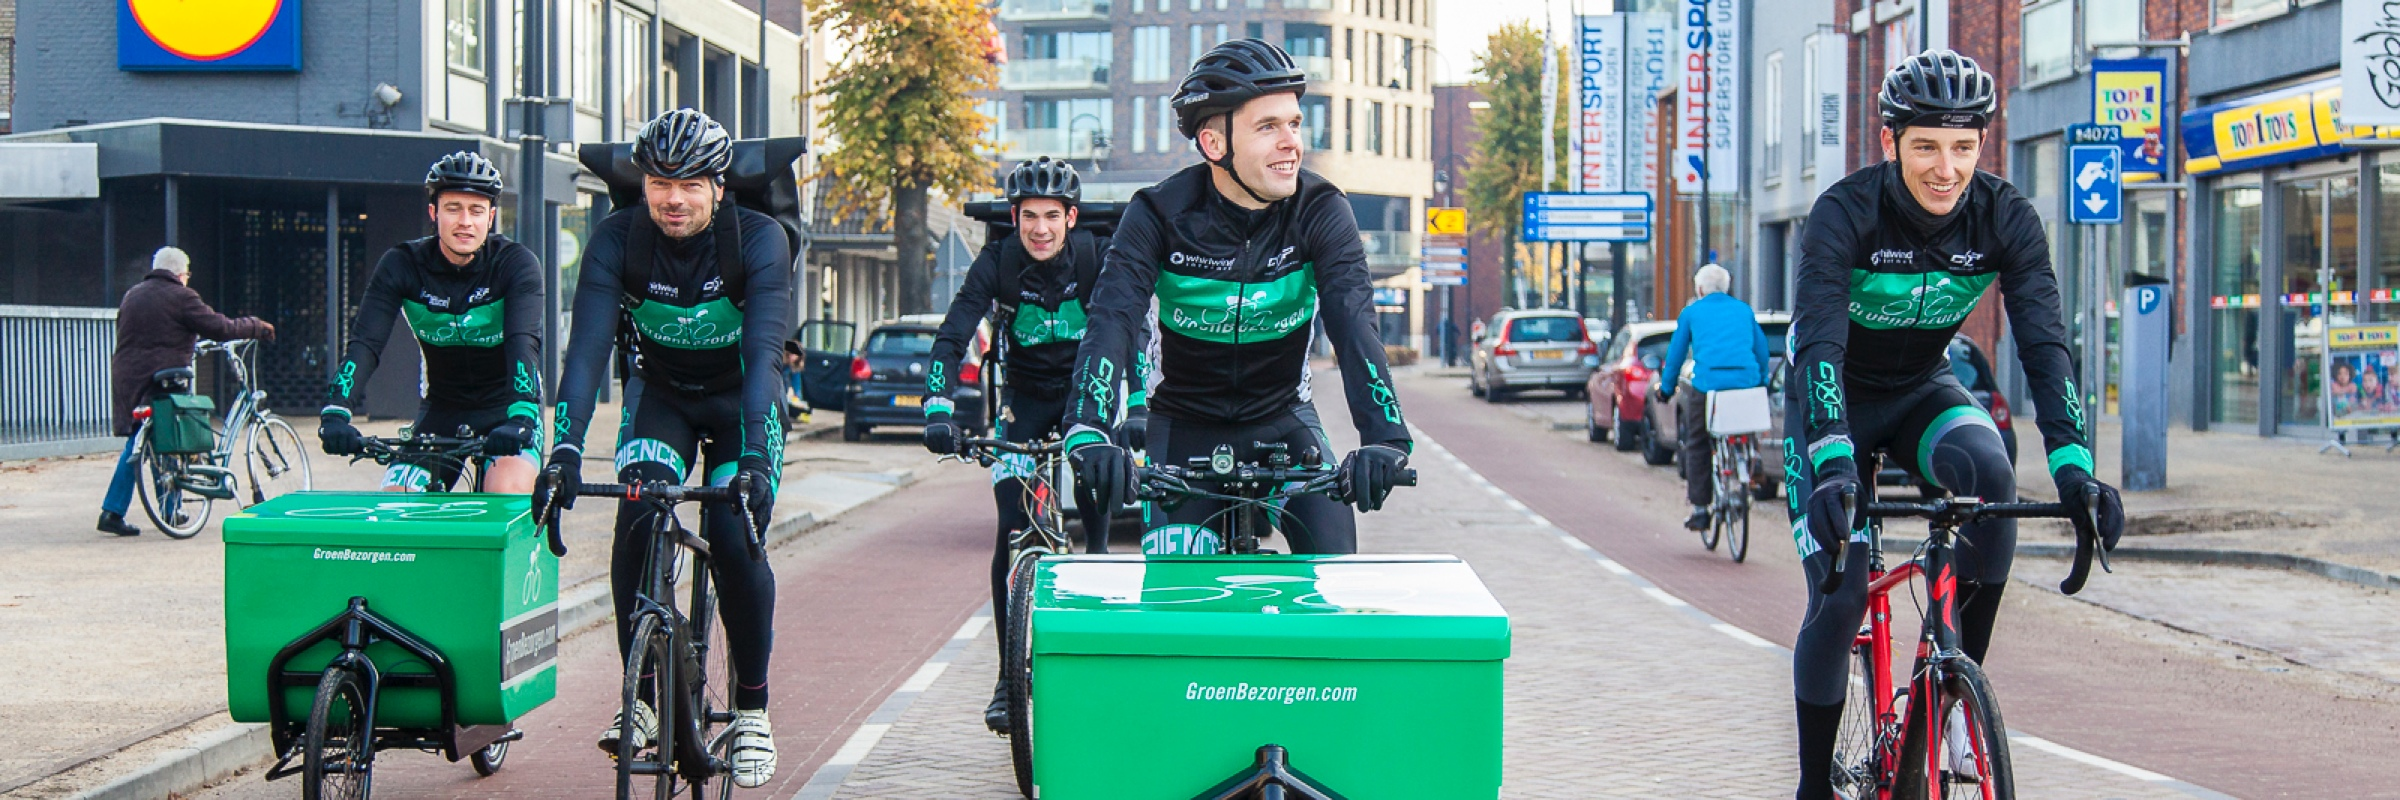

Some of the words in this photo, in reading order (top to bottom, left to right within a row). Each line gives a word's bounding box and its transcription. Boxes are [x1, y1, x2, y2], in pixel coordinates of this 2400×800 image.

[1606, 47, 1618, 87] UDEN
[1582, 27, 1602, 188] INTERSPORT
[1716, 29, 1731, 150] SUPERSTORE
[2103, 89, 2140, 104] TOP
[2144, 86, 2154, 103] 1
[2106, 107, 2152, 122] TOYS
[2230, 121, 2255, 149] TOP
[2265, 112, 2298, 142] TOYS
[1606, 90, 1618, 188] SUPERSTORE
[313, 548, 416, 563] GroenBezorgen.com
[1186, 682, 1357, 704] GroenBezorgen.com
